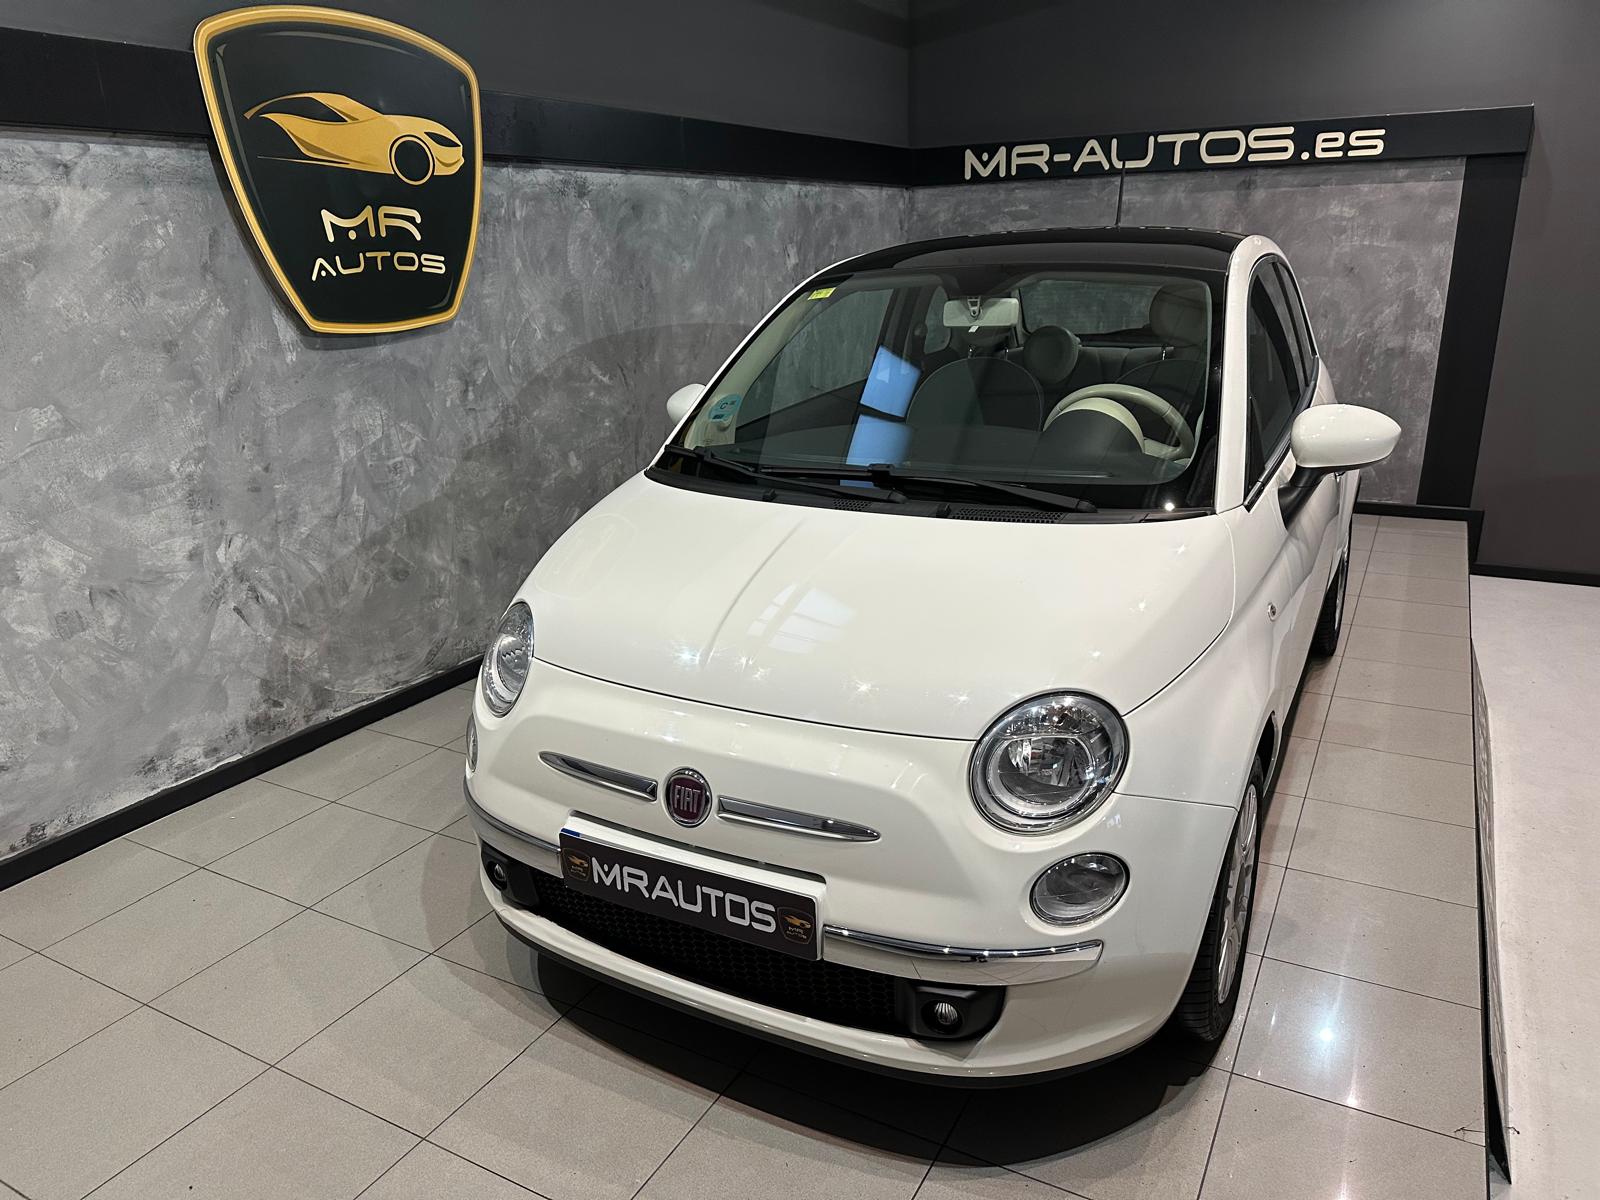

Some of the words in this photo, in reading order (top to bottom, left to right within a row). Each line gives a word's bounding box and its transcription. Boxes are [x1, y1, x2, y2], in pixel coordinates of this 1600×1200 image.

[964, 126, 1386, 180] MR-AUTOS.es
[321, 205, 422, 243] MR
[312, 251, 446, 281] AUTOS
[674, 785, 701, 813] FIAT
